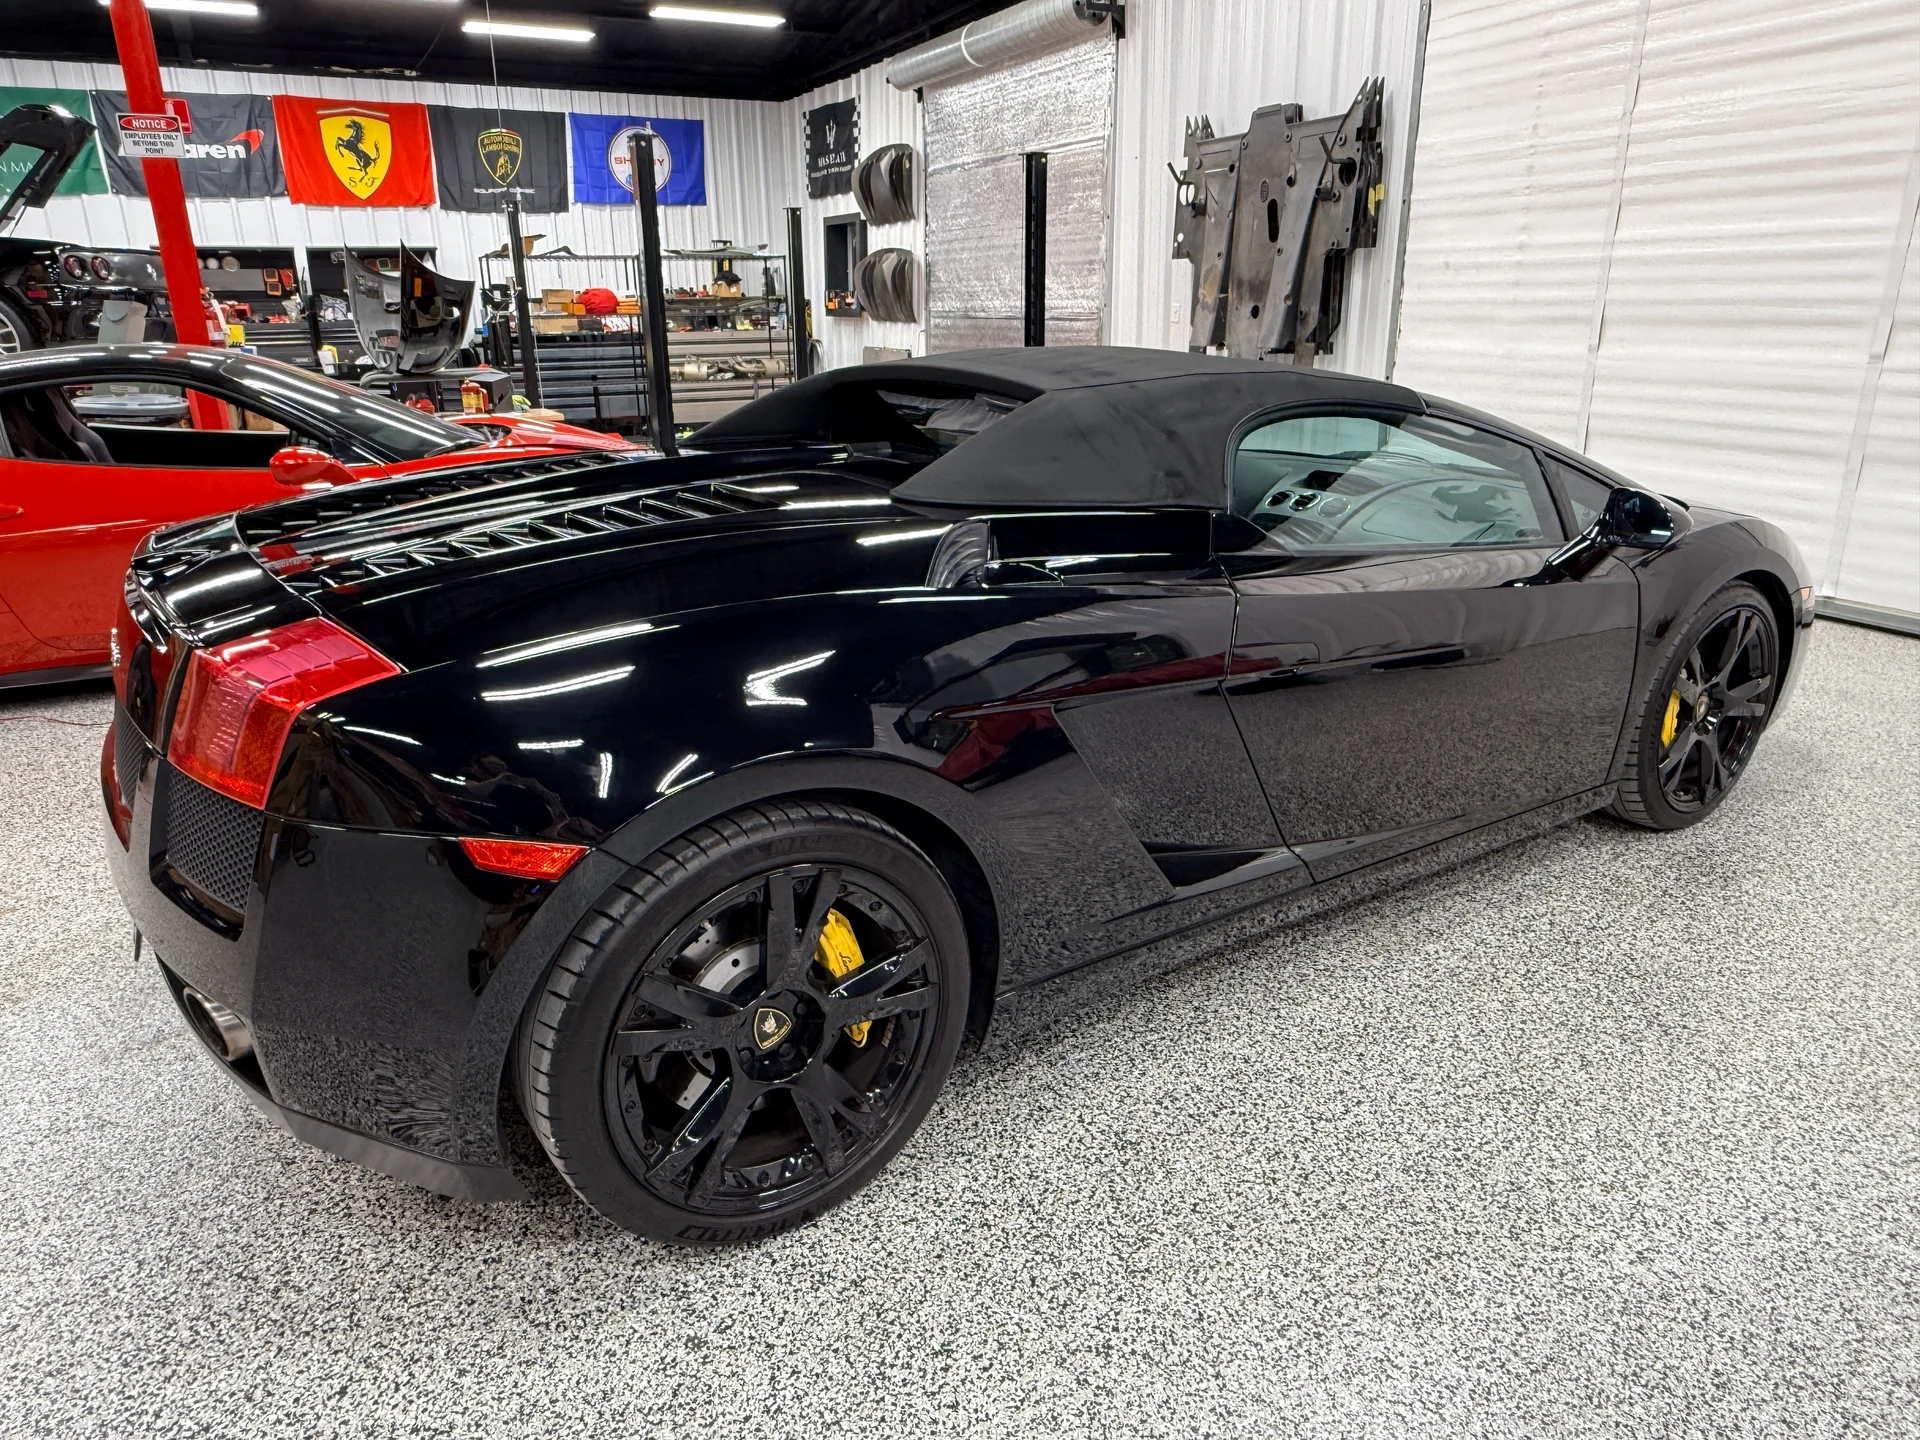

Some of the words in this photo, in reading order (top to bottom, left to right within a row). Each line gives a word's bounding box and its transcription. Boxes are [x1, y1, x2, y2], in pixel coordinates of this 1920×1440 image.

[132, 118, 167, 129] NOTICE
[124, 132, 161, 140] EMPLOYEES
[162, 133, 179, 141] ONLY
[145, 147, 164, 155] POINT
